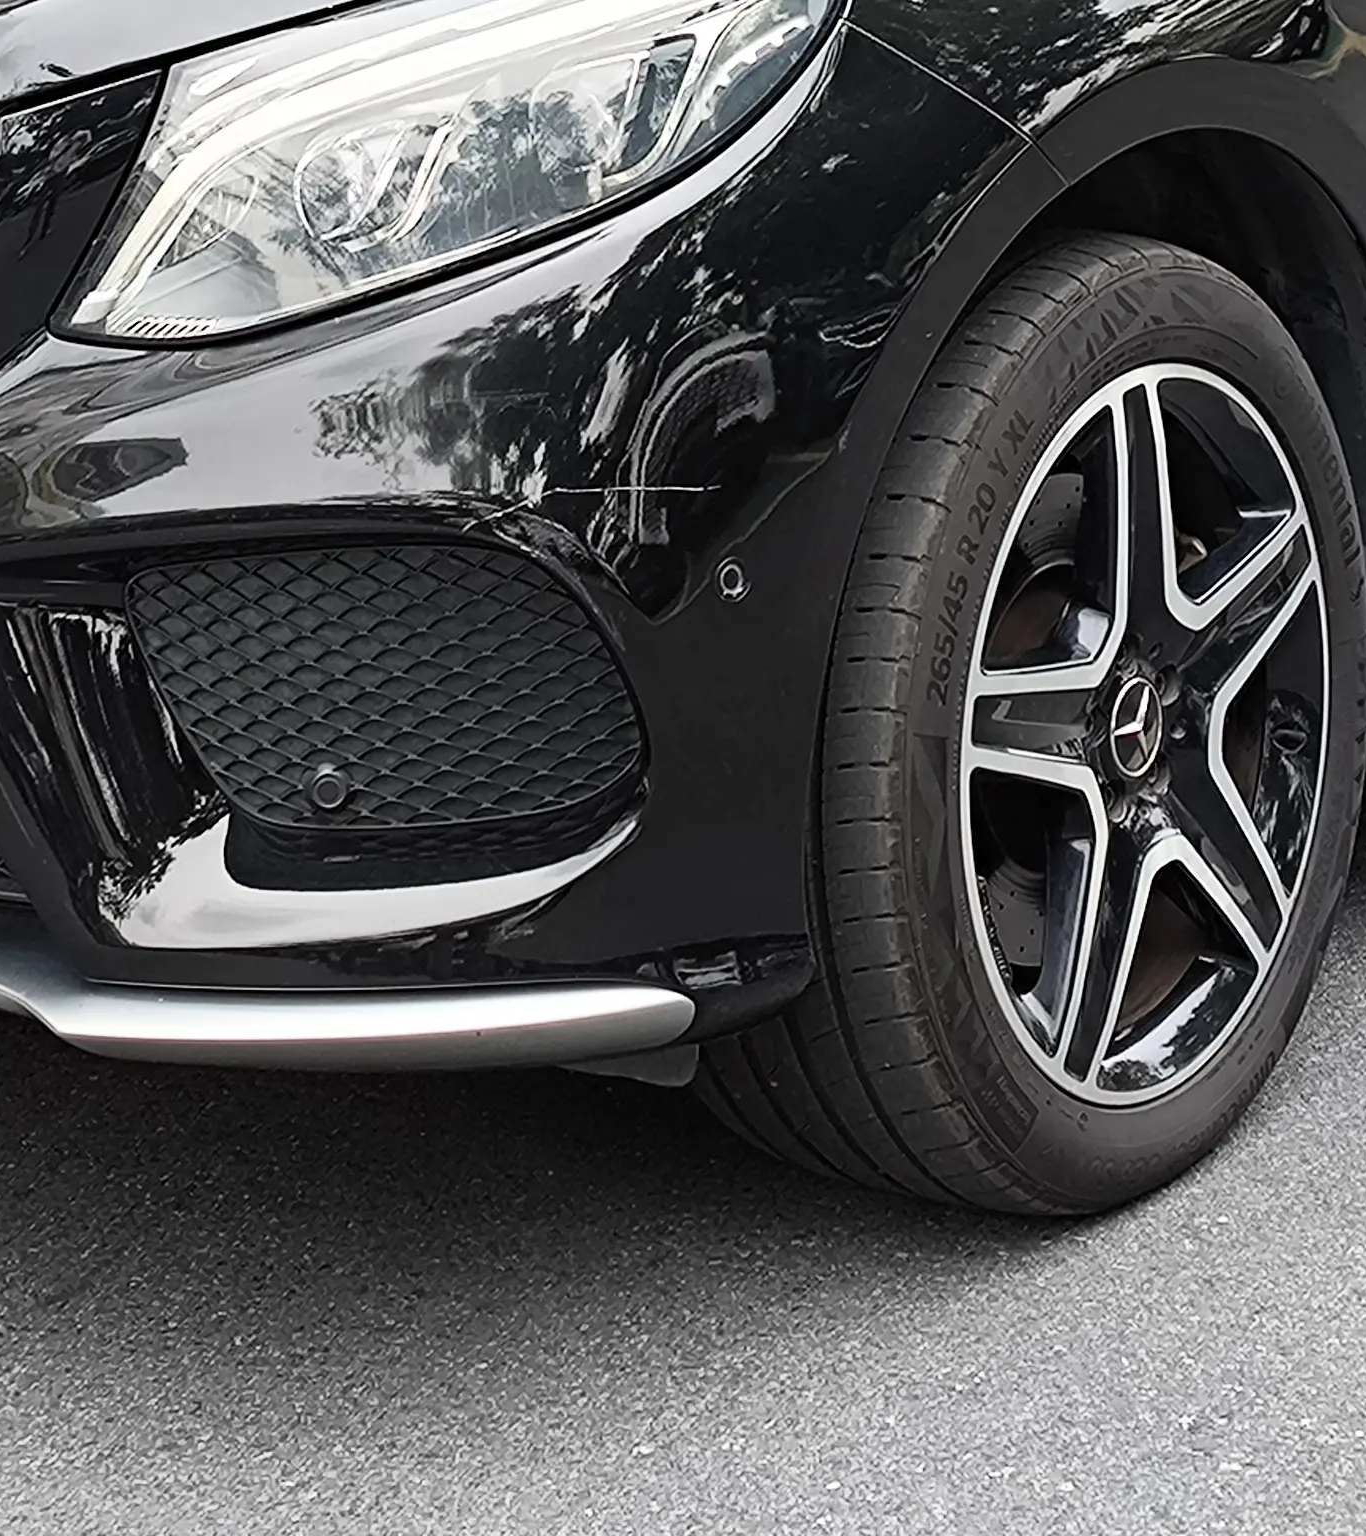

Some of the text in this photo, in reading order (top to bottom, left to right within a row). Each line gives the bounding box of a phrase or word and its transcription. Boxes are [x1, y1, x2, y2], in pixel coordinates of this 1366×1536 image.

[927, 408, 1036, 707] 265/45 R 20 Y XL
